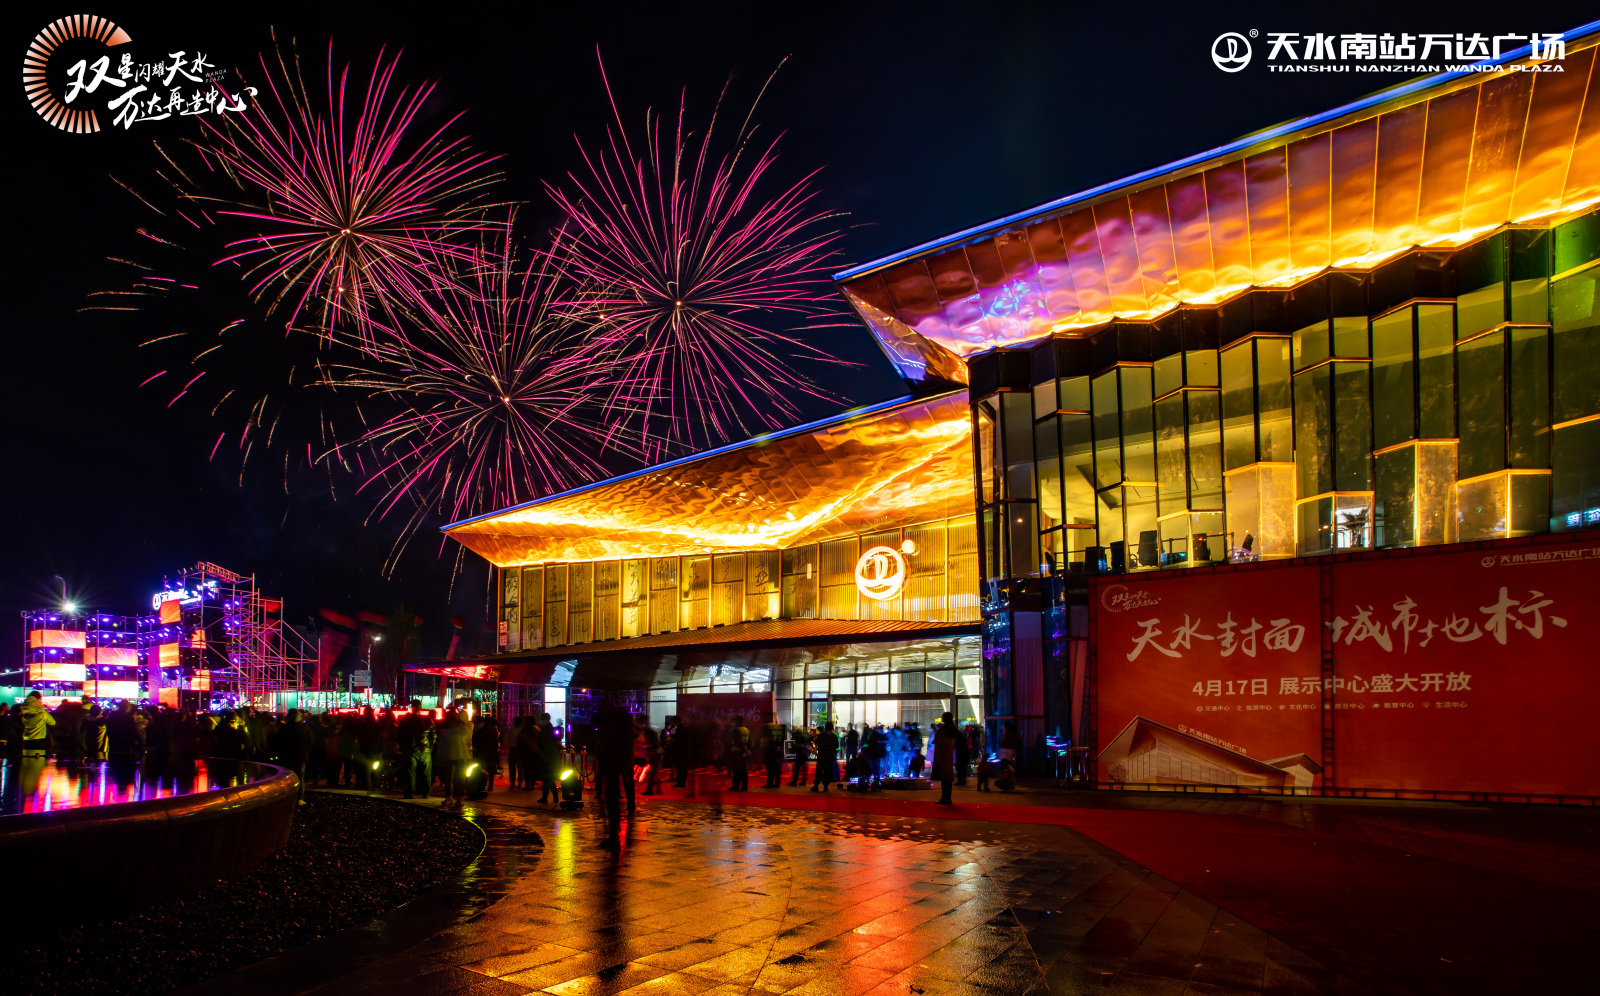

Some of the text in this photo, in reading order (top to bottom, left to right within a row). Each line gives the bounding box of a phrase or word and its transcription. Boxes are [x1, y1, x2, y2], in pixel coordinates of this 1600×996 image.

[1126, 586, 1568, 663] 天水封面 城市地标
[1192, 671, 1473, 697] 4月17日 展示中心盛大开放
[1435, 701, 1468, 709] 生活中心
